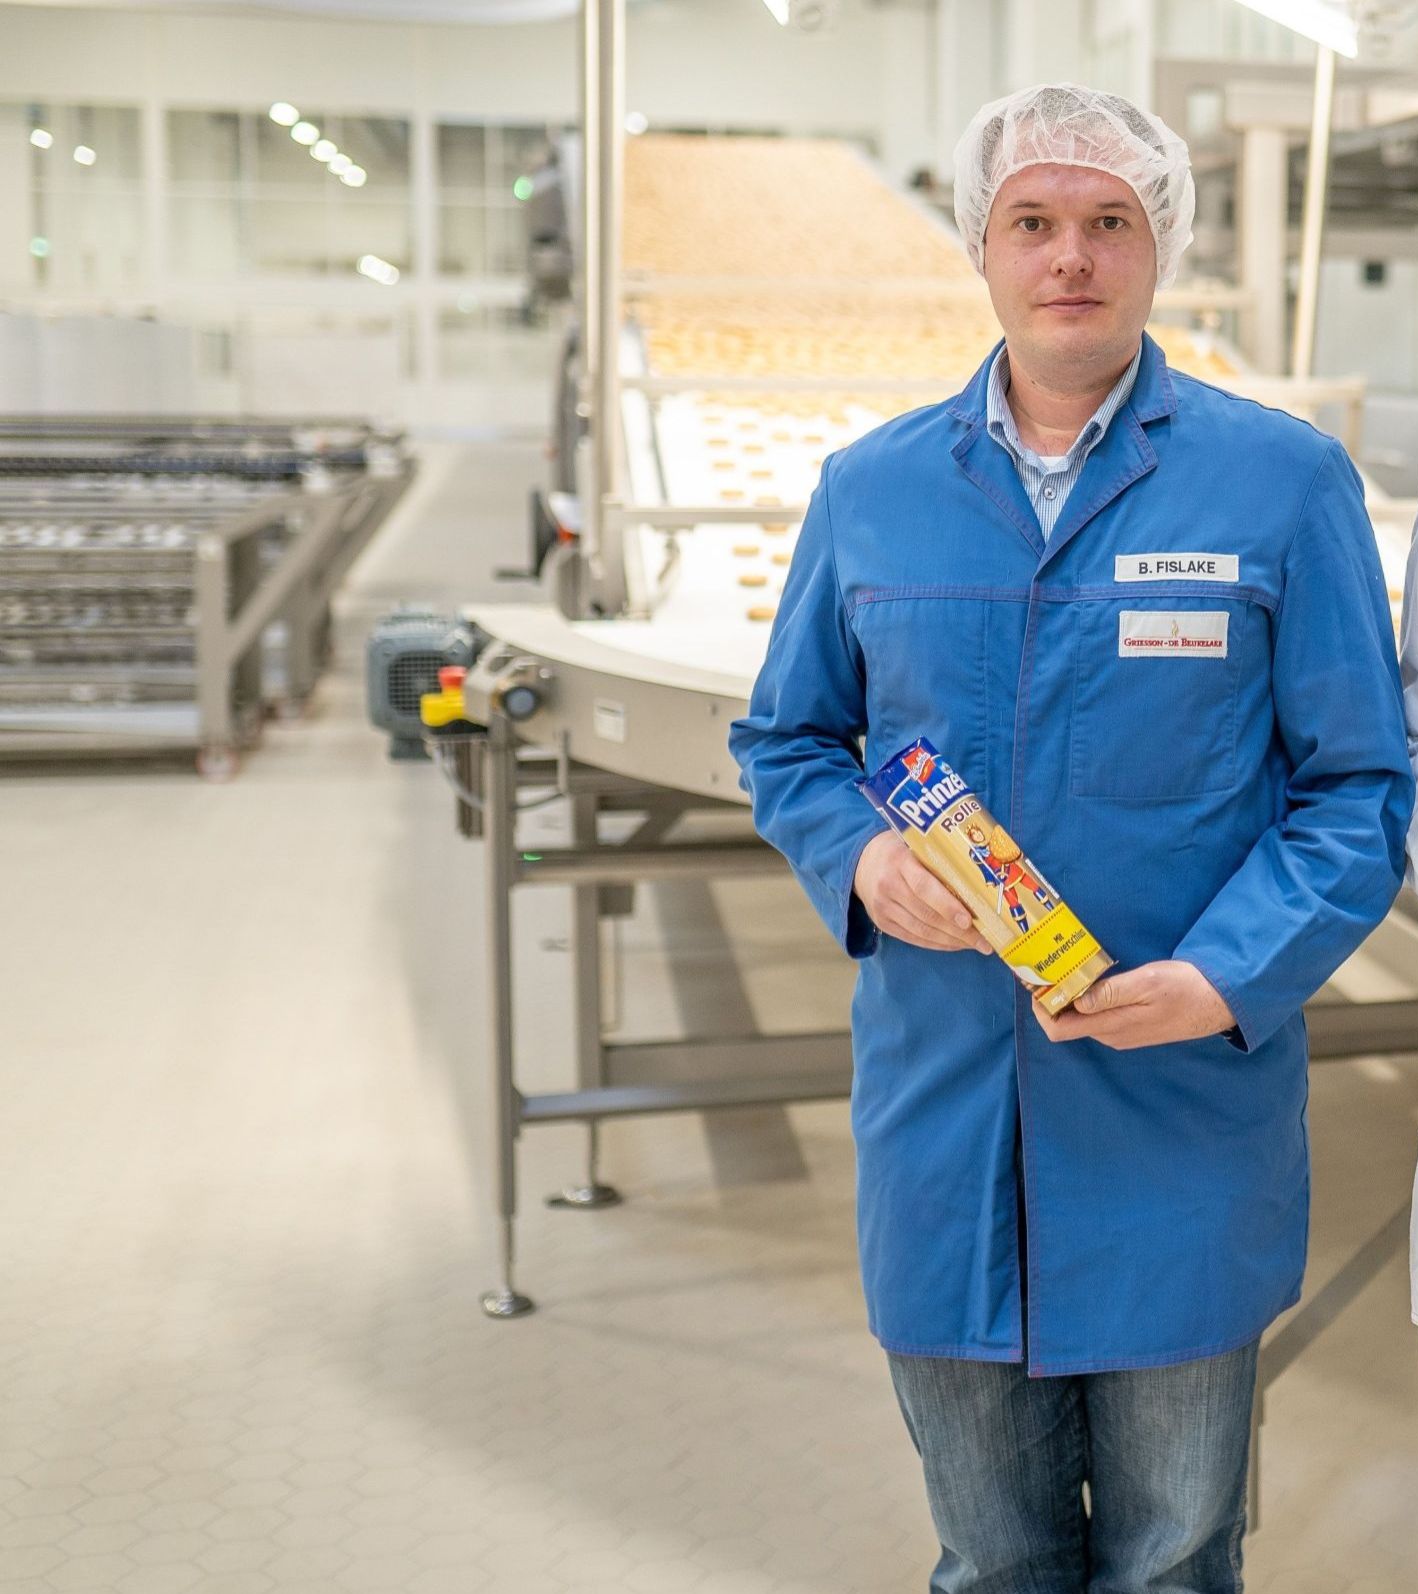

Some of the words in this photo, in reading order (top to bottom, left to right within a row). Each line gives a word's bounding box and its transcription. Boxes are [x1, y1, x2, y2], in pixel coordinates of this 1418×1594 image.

[1138, 561, 1152, 575] B.
[1156, 560, 1216, 574] FISLAKE
[941, 801, 980, 833] Rolle
